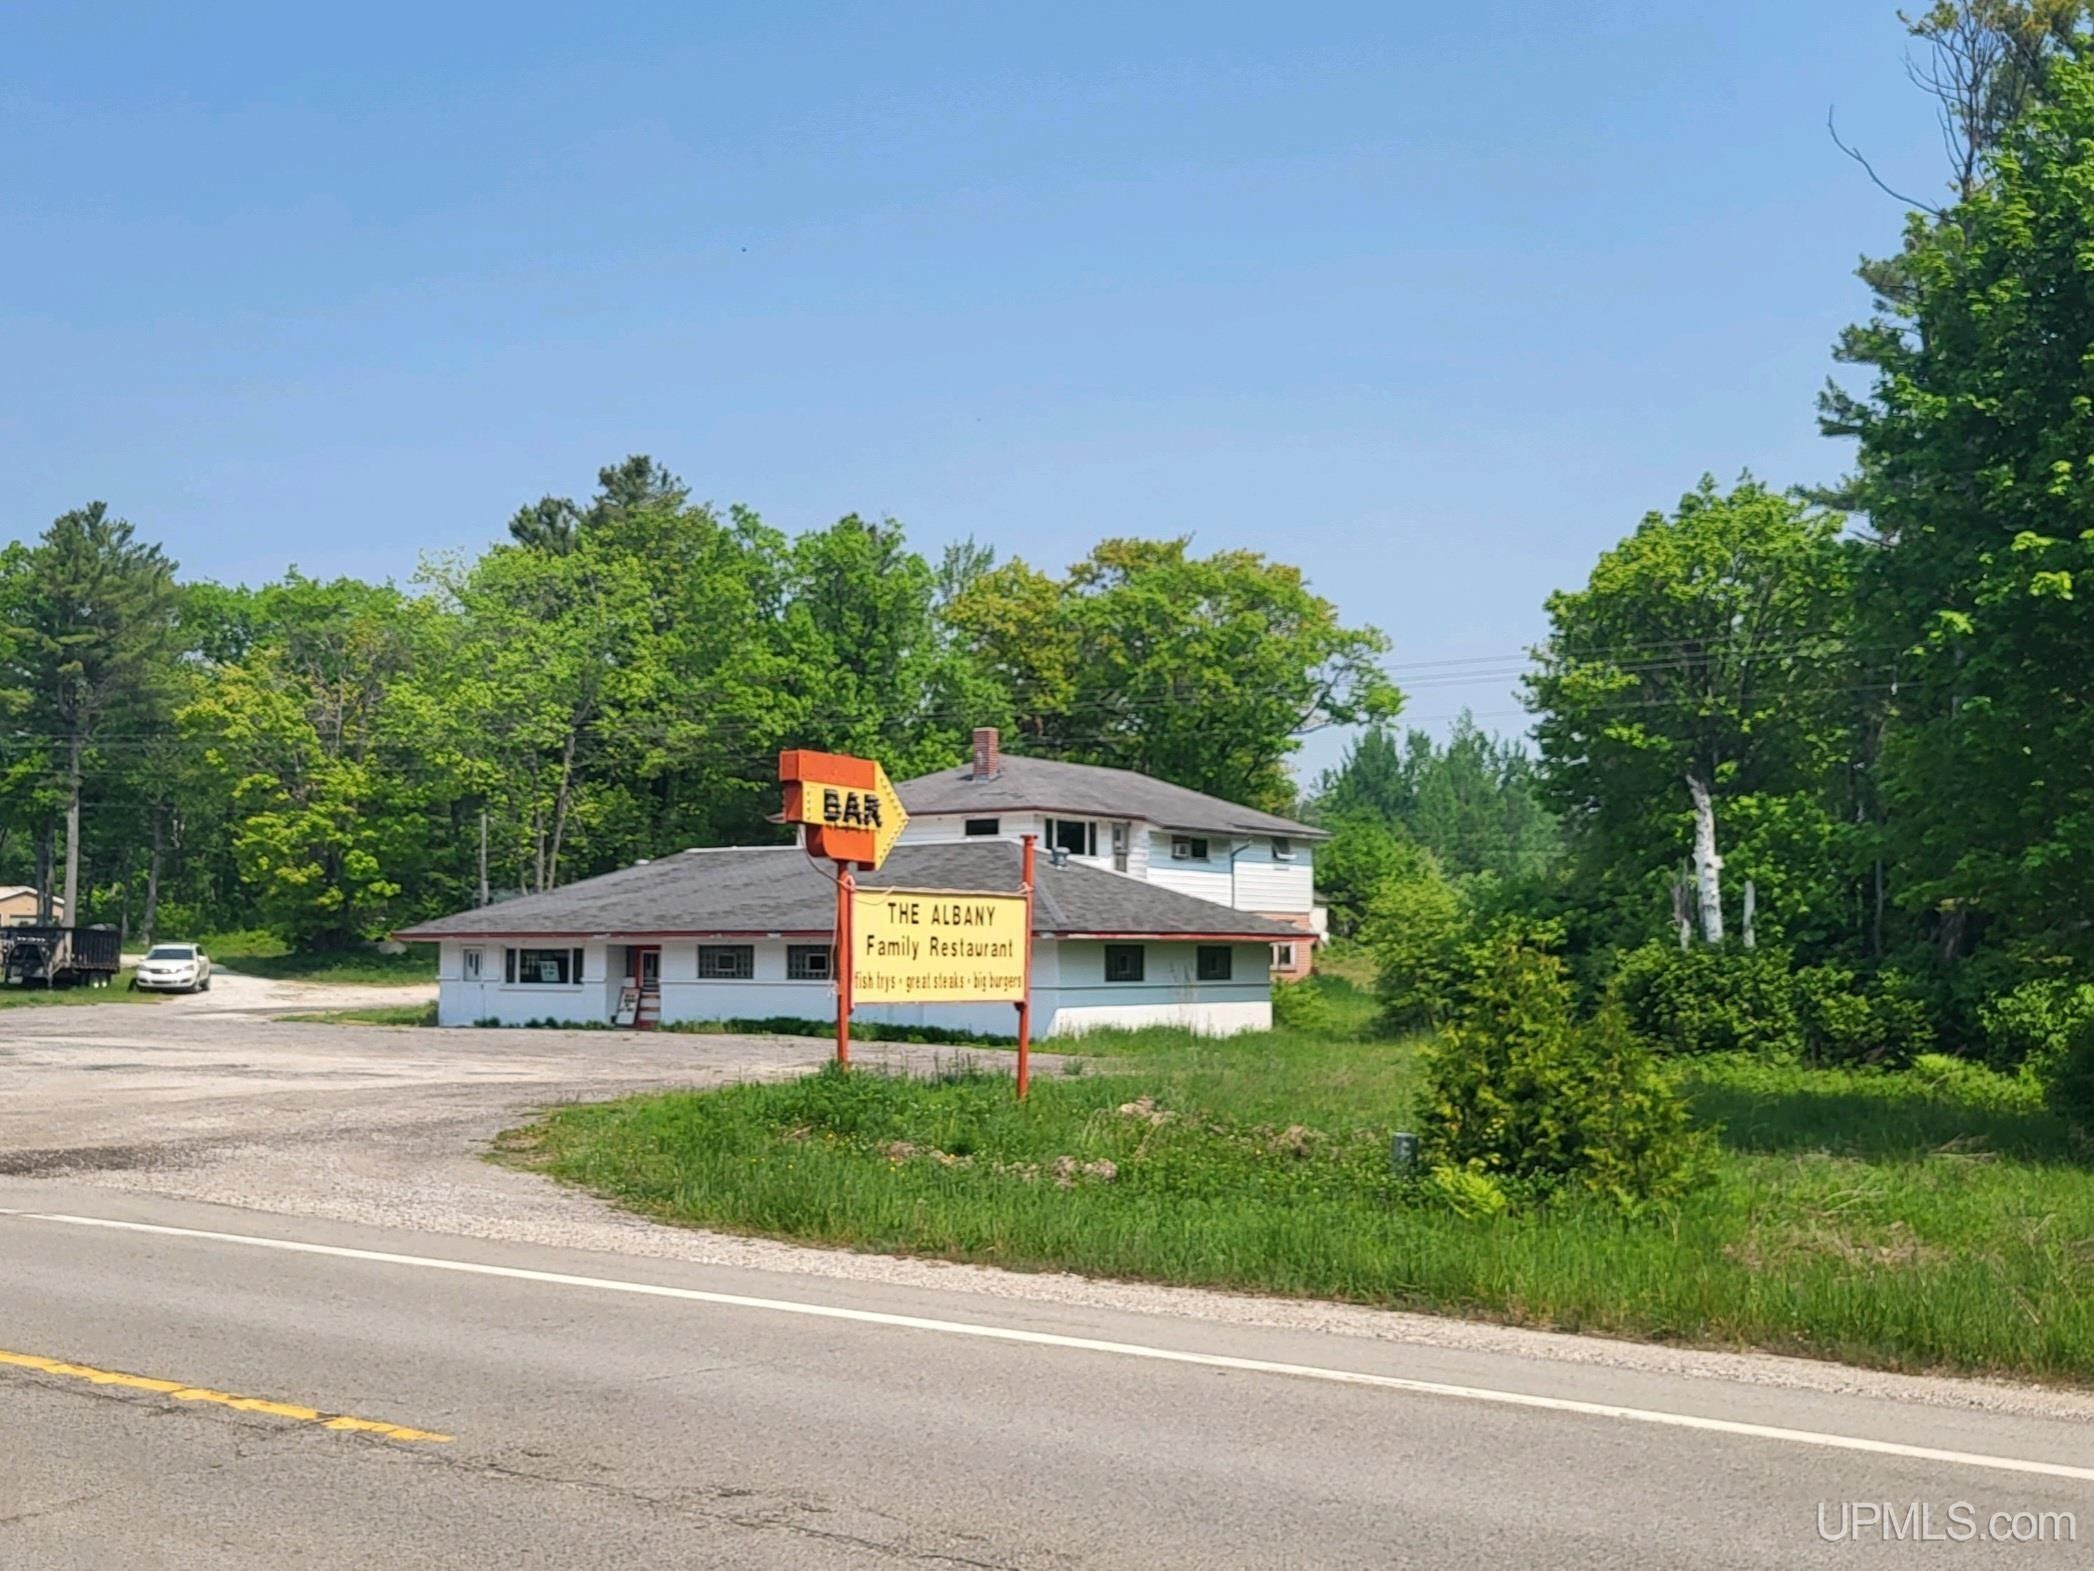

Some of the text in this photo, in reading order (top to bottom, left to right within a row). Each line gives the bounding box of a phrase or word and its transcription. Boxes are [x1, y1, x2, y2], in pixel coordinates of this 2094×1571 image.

[823, 788, 882, 828] BAR
[888, 902, 996, 926] THE ALBANY
[866, 934, 1014, 960] Family Restaurant
[854, 971, 873, 989] fish
[906, 971, 931, 993] great
[933, 971, 964, 989] steaks
[973, 971, 987, 992] big
[988, 971, 1022, 992] burgers
